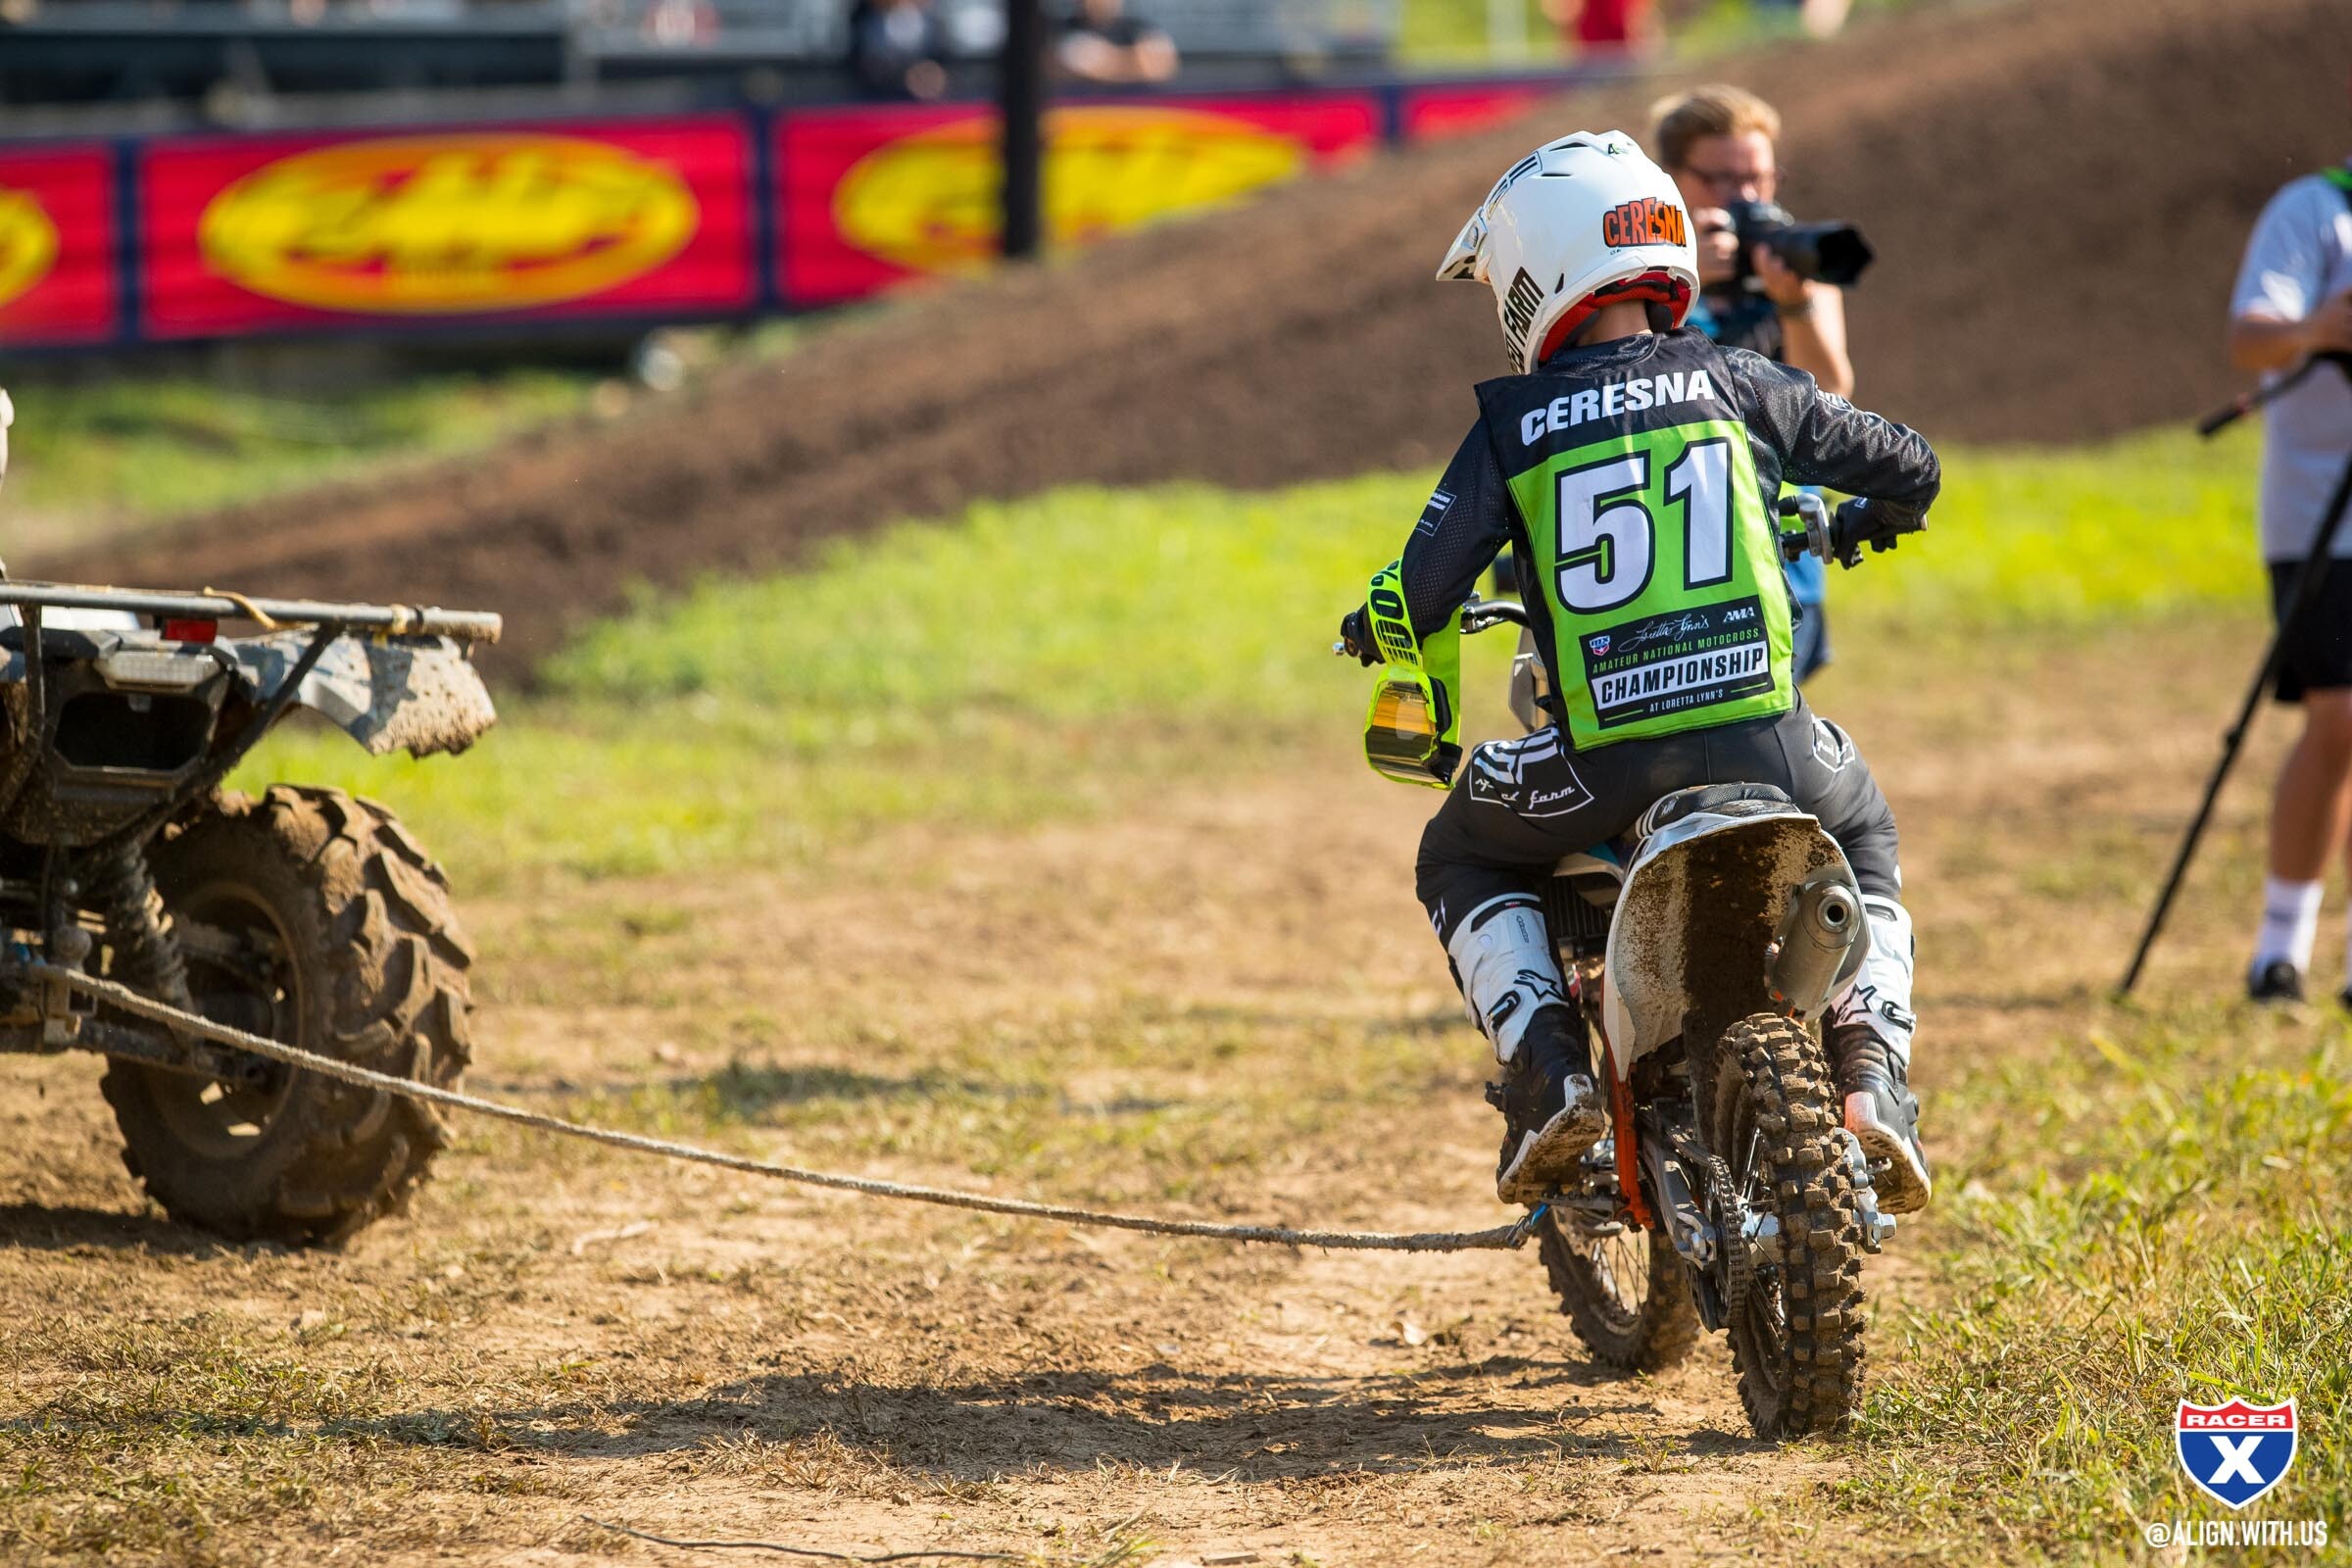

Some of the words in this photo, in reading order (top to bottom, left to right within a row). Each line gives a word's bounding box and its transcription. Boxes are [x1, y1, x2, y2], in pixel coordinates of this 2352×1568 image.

[1603, 197, 1687, 248] CERESNA
[1503, 266, 1545, 348] FARM
[1520, 369, 1716, 447] CERESNA
[1554, 437, 1734, 615] 51
[1673, 613, 1709, 642] Lynn's
[1723, 607, 1755, 623] AMA
[1592, 654, 1639, 674] AMATEUR
[1642, 643, 1693, 661] NATIONAL
[1697, 628, 1759, 650] MOTOCROSS
[1601, 647, 1764, 705] CHAMPIONSHIP
[1649, 702, 1660, 713] AT
[1661, 695, 1694, 710] LORETTA
[1696, 689, 1724, 702] LYNN'S
[1528, 786, 1576, 810] farm
